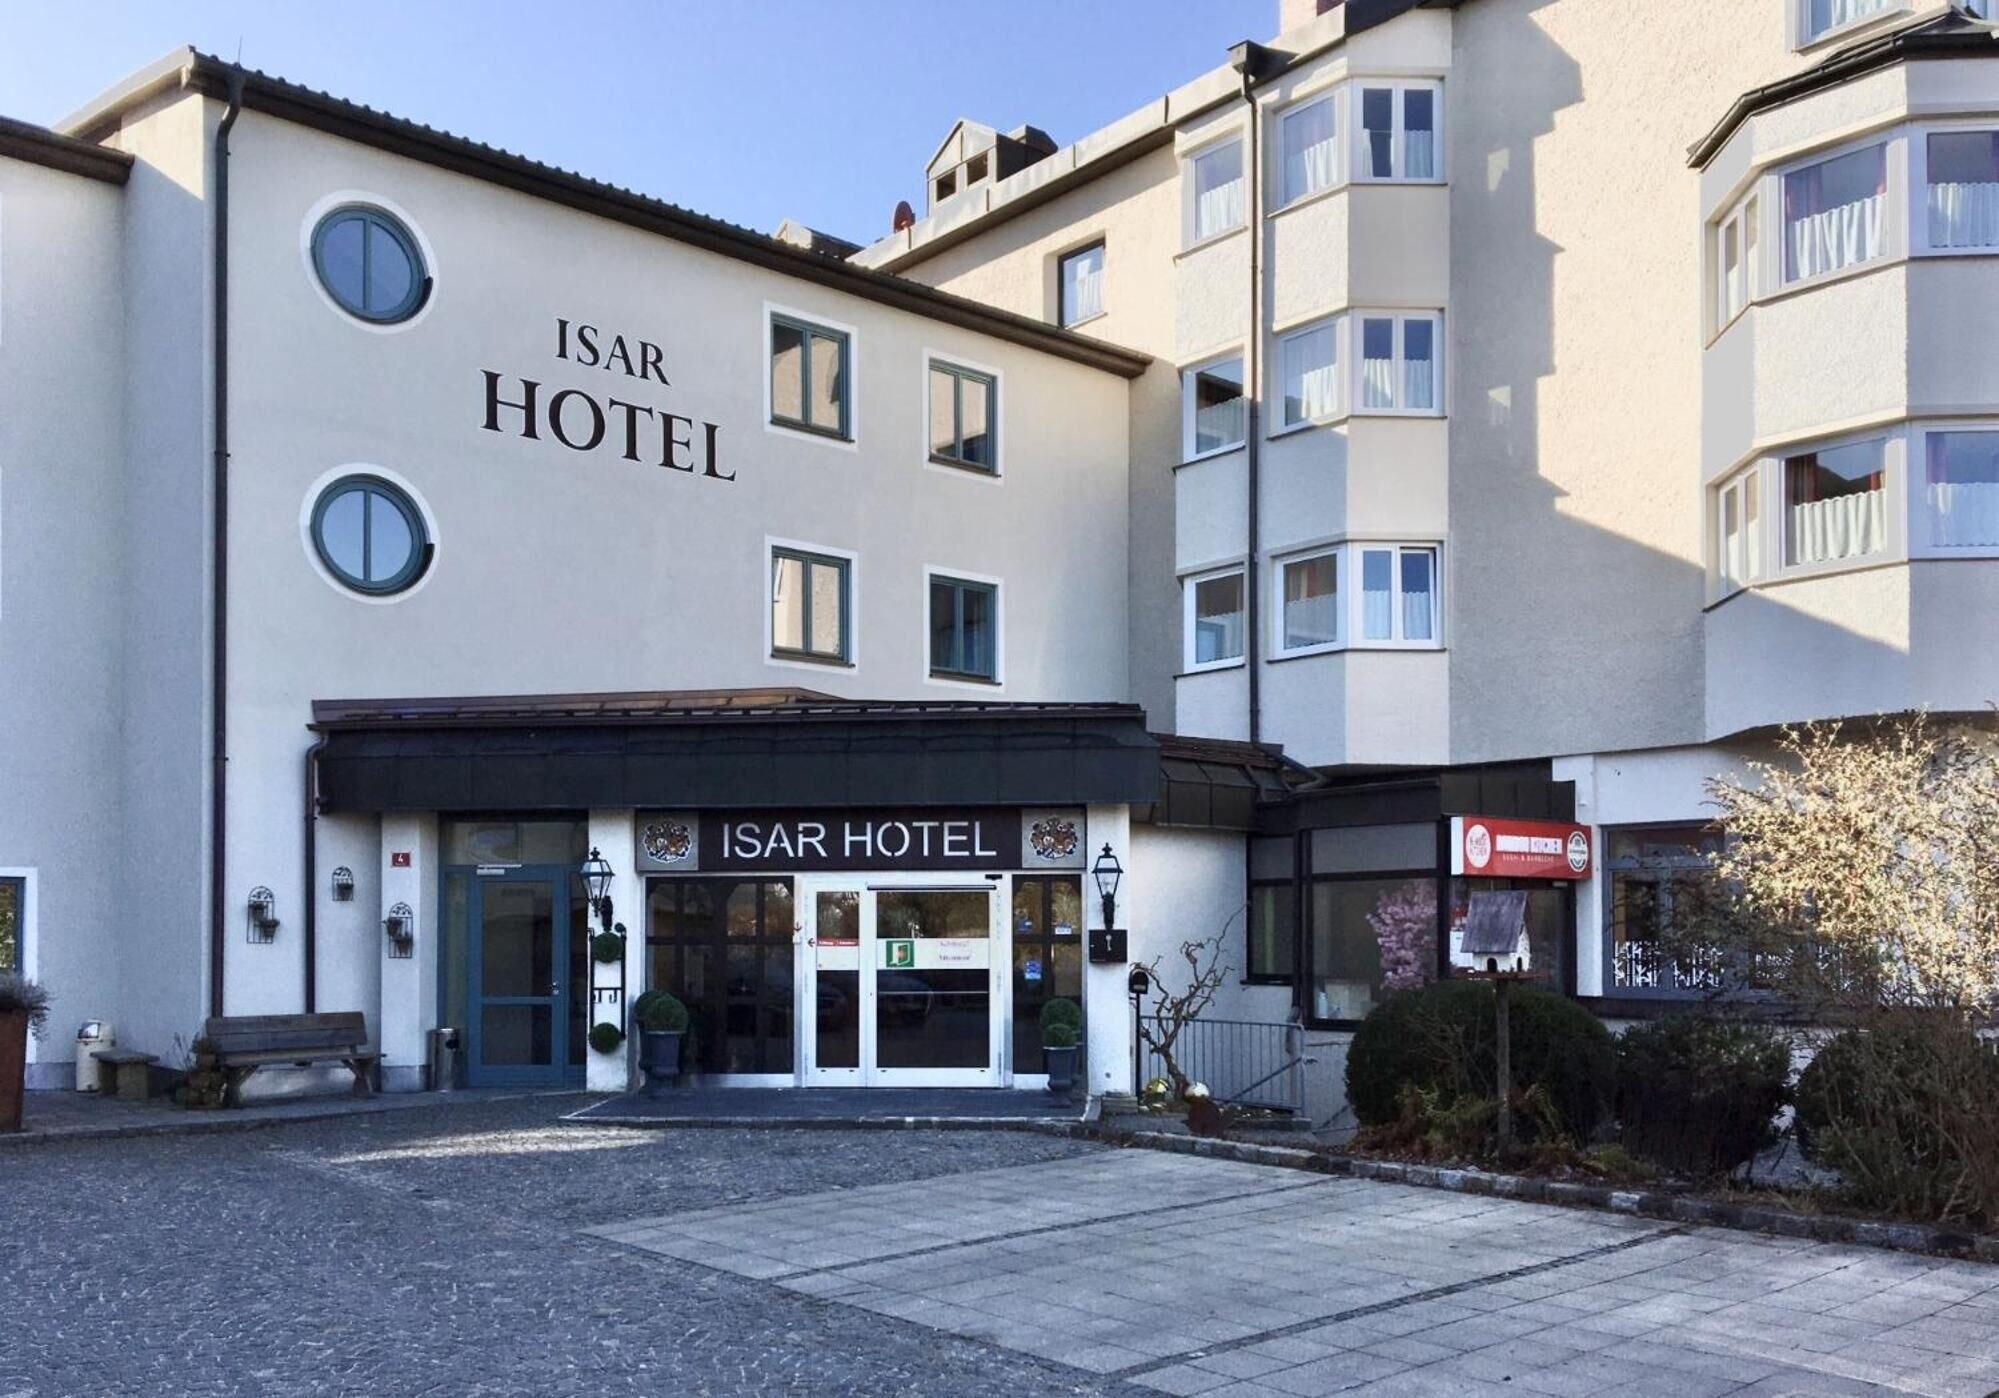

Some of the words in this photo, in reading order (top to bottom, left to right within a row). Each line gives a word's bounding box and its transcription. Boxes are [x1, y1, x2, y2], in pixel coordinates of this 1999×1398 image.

[556, 318, 671, 386] ISAR
[480, 369, 736, 482] HOTEL
[723, 822, 828, 858] ISAR
[844, 821, 997, 858] HOTEL
